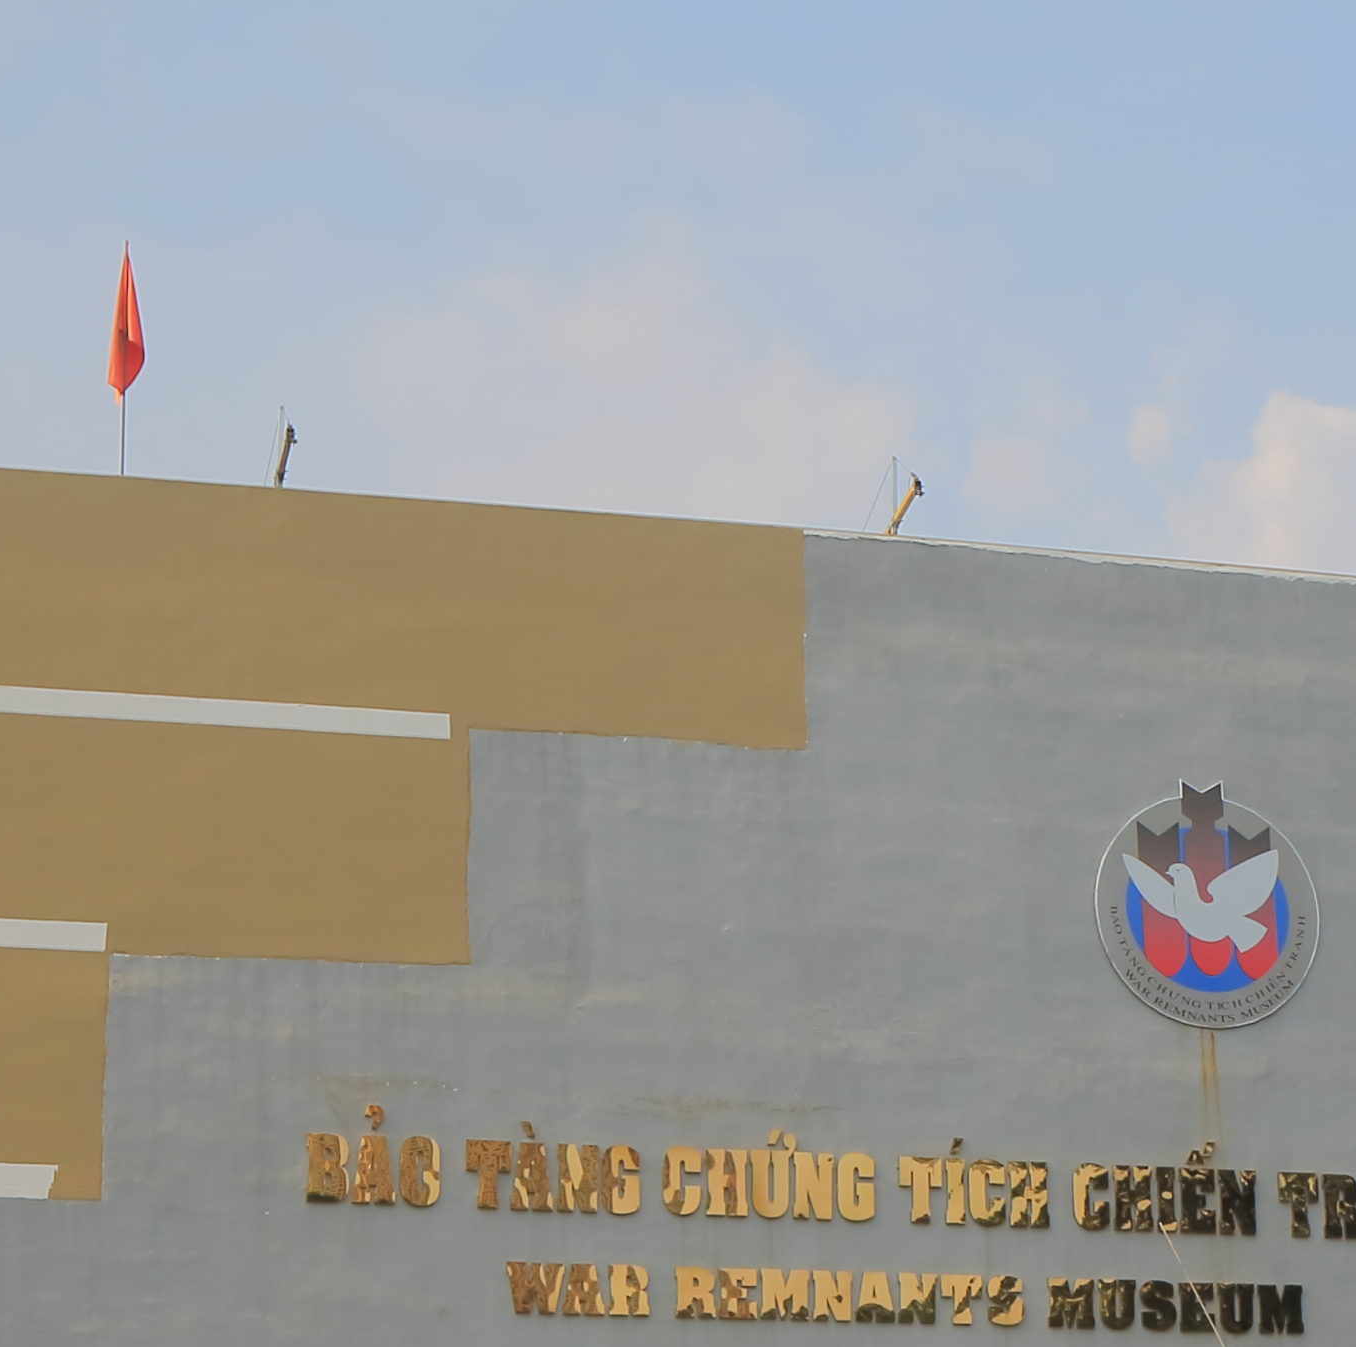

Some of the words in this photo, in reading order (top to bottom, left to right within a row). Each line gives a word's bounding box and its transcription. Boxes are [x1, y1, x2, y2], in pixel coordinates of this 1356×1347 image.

[1285, 915, 1306, 970] TRANH
[1126, 968, 1151, 998] WAR
[1153, 996, 1236, 1023] REMNANTS
[1240, 980, 1295, 1019] MUSEUM
[306, 1104, 441, 1207] BẢO
[465, 1121, 641, 1215] TÀNG
[661, 1129, 876, 1222] CHỨNG
[897, 1137, 1051, 1229] TÍCH
[1072, 1141, 1258, 1237] CHIẾN
[506, 1261, 650, 1317] WAR
[674, 1266, 1024, 1327] REMNANTS
[1047, 1276, 1305, 1335] MUSEUM
